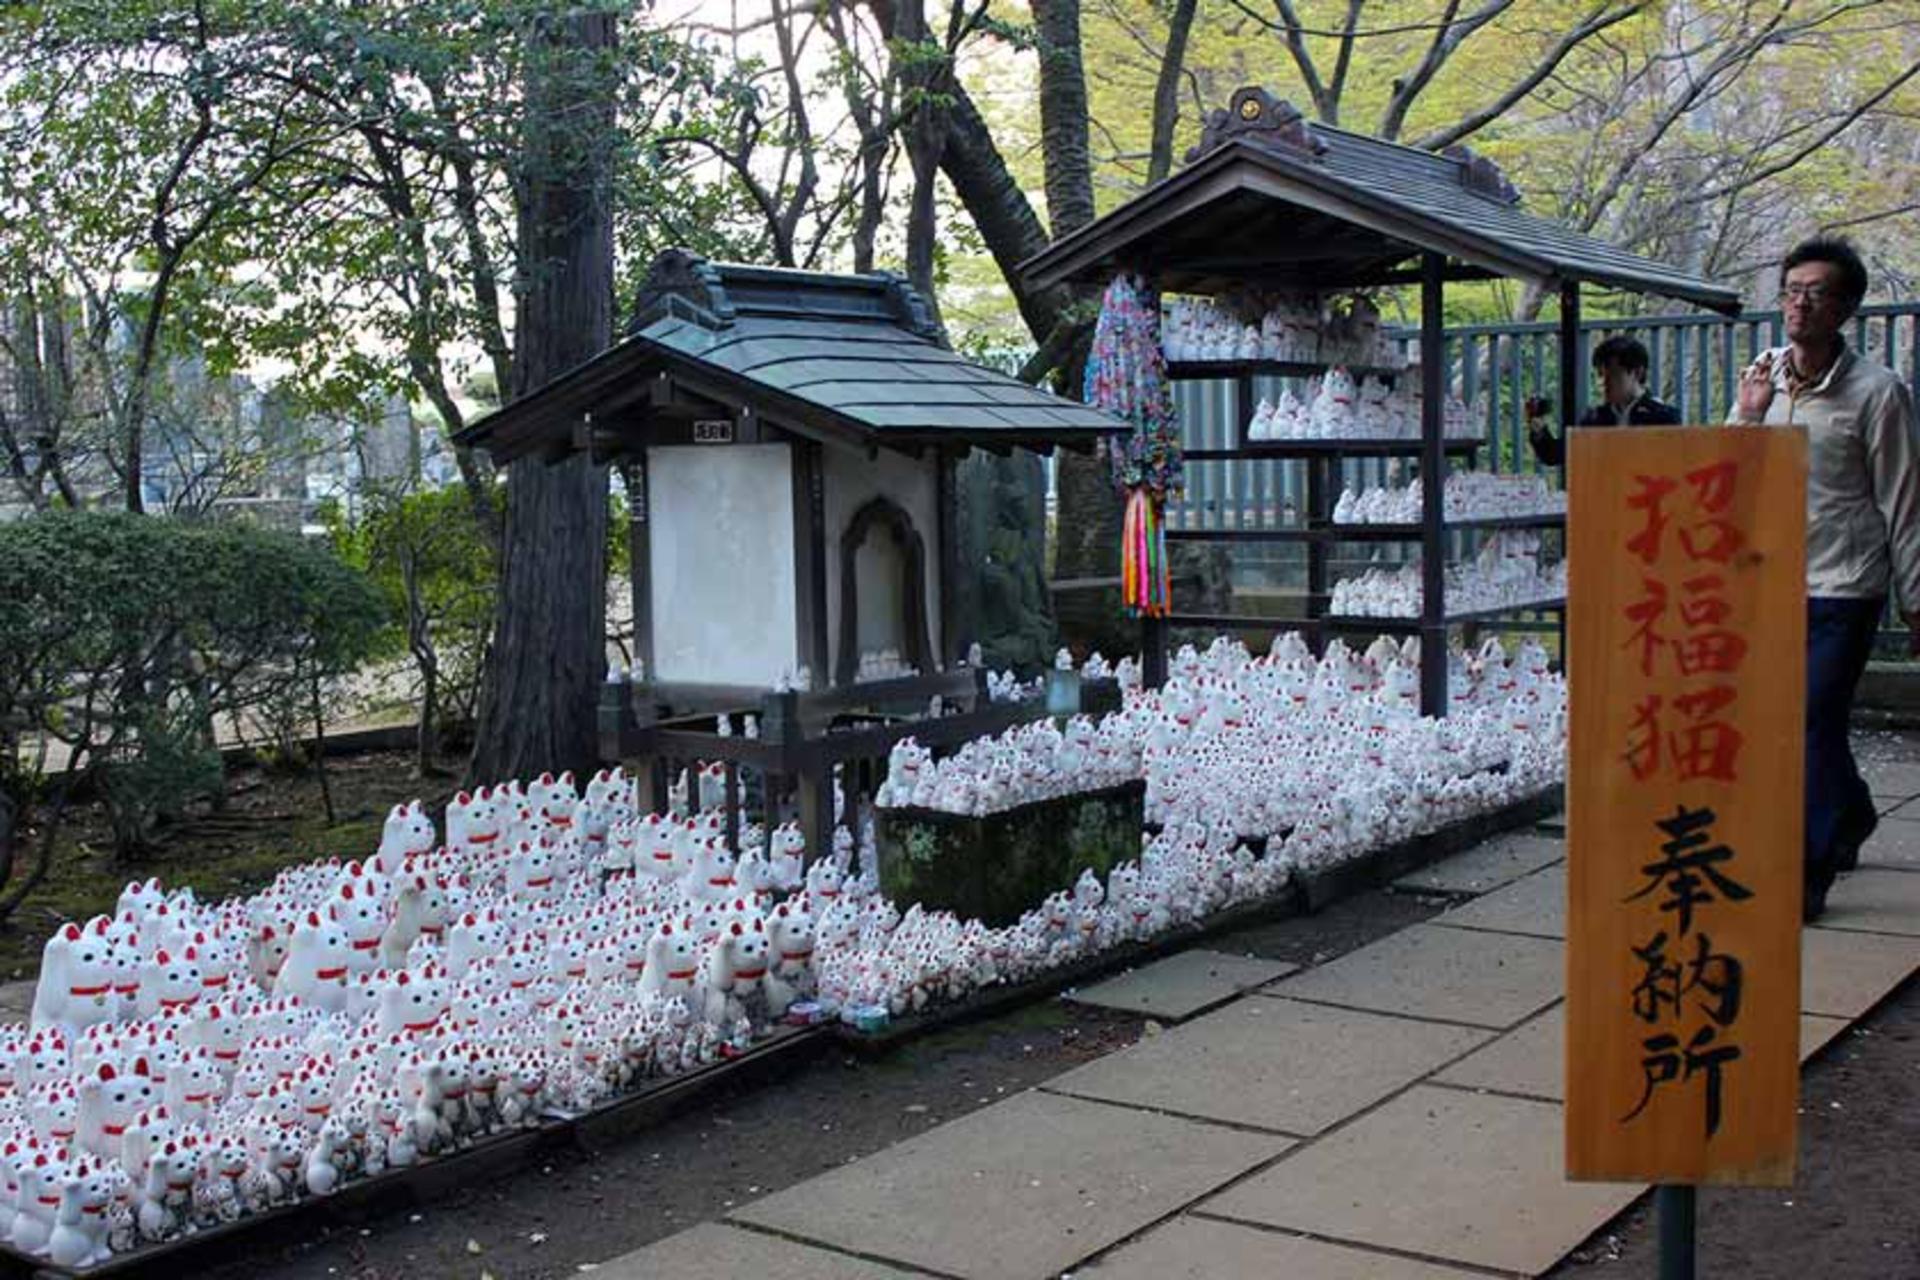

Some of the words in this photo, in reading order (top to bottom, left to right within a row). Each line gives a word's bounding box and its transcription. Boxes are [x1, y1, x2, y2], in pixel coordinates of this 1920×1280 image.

[1620, 459, 1754, 1141] 招福猫奉納所
